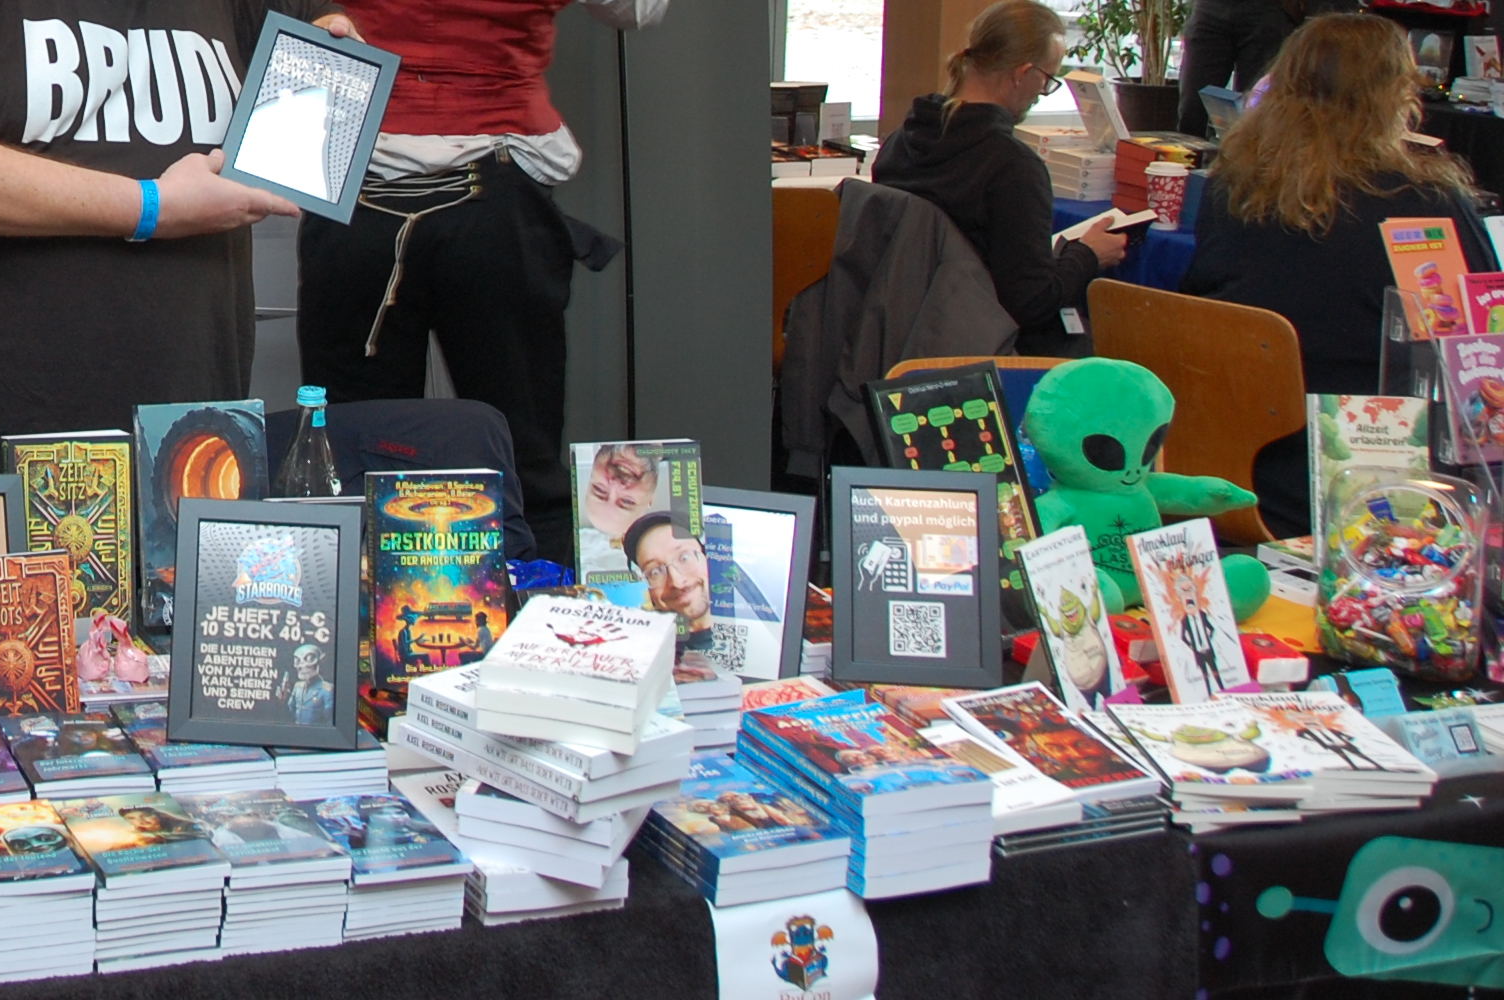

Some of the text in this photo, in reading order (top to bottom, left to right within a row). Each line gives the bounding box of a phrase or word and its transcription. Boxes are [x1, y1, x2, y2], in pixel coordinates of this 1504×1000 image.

[852, 494, 976, 514] Auch Kartenzahlung
[853, 513, 976, 530] und paypal möglich
[379, 531, 501, 552] ERSTKONTAKT
[236, 582, 303, 607] STARBOOZE
[933, 580, 971, 593] PayPal
[205, 606, 281, 625] JE HEFT
[200, 621, 274, 640] 10 STCK
[200, 642, 277, 658] DIE LUSTIGEN
[203, 654, 274, 668] ABENTEUER
[197, 663, 223, 677] VON
[201, 676, 273, 690] KARL-HEINZ
[202, 686, 271, 701] UND SEINER
[217, 697, 256, 710] CREW
